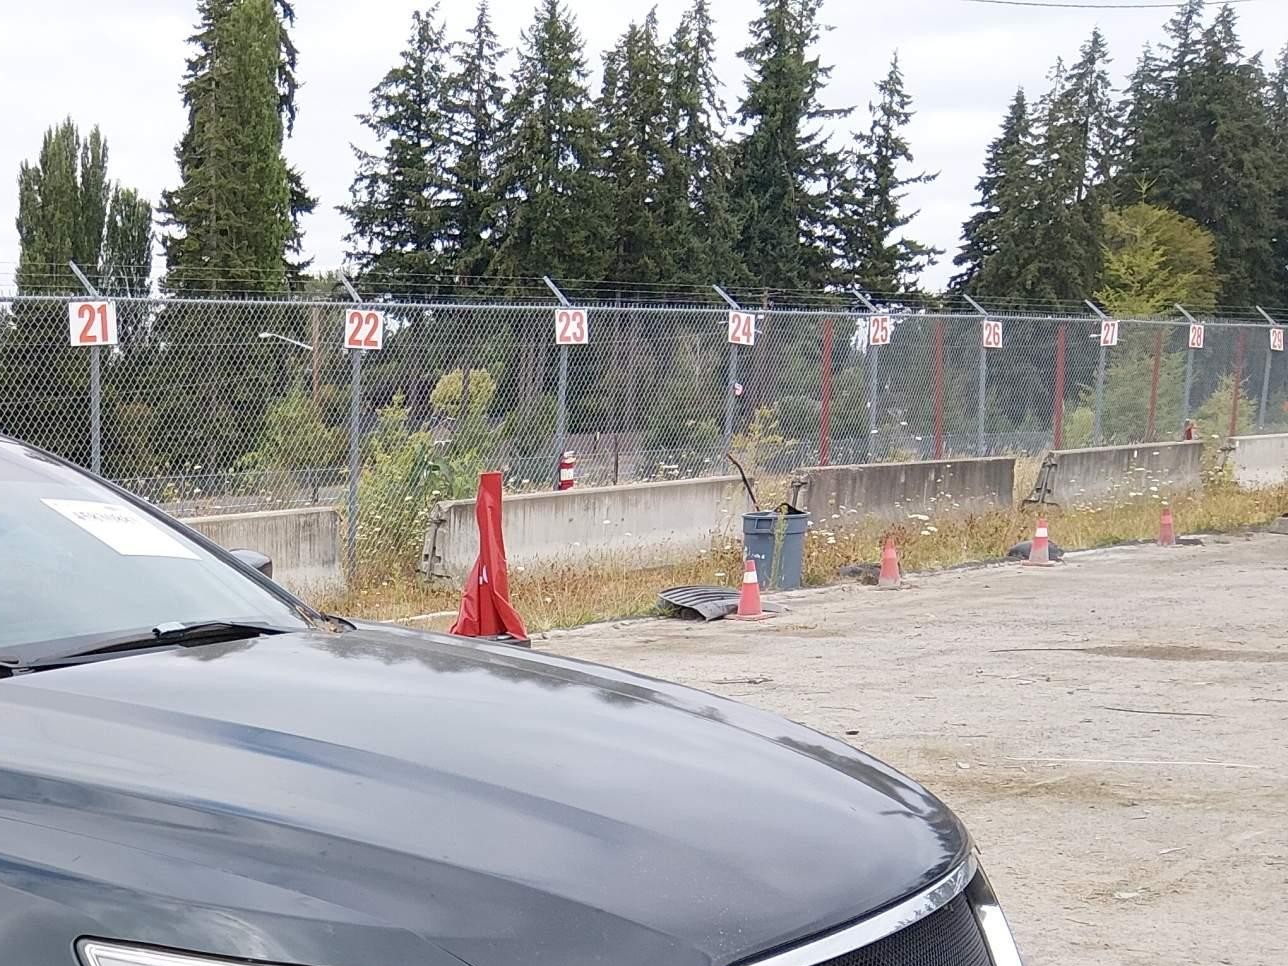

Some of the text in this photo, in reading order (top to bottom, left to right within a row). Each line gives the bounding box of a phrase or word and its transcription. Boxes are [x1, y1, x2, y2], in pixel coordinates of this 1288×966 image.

[78, 304, 108, 342] 21
[348, 312, 379, 346] 22
[558, 312, 584, 342] 23
[730, 314, 752, 344] 24
[872, 318, 888, 343] 25
[985, 323, 1000, 346] 26
[1103, 323, 1116, 344] 27
[1191, 326, 1202, 346] 28
[1272, 330, 1282, 350] 29
